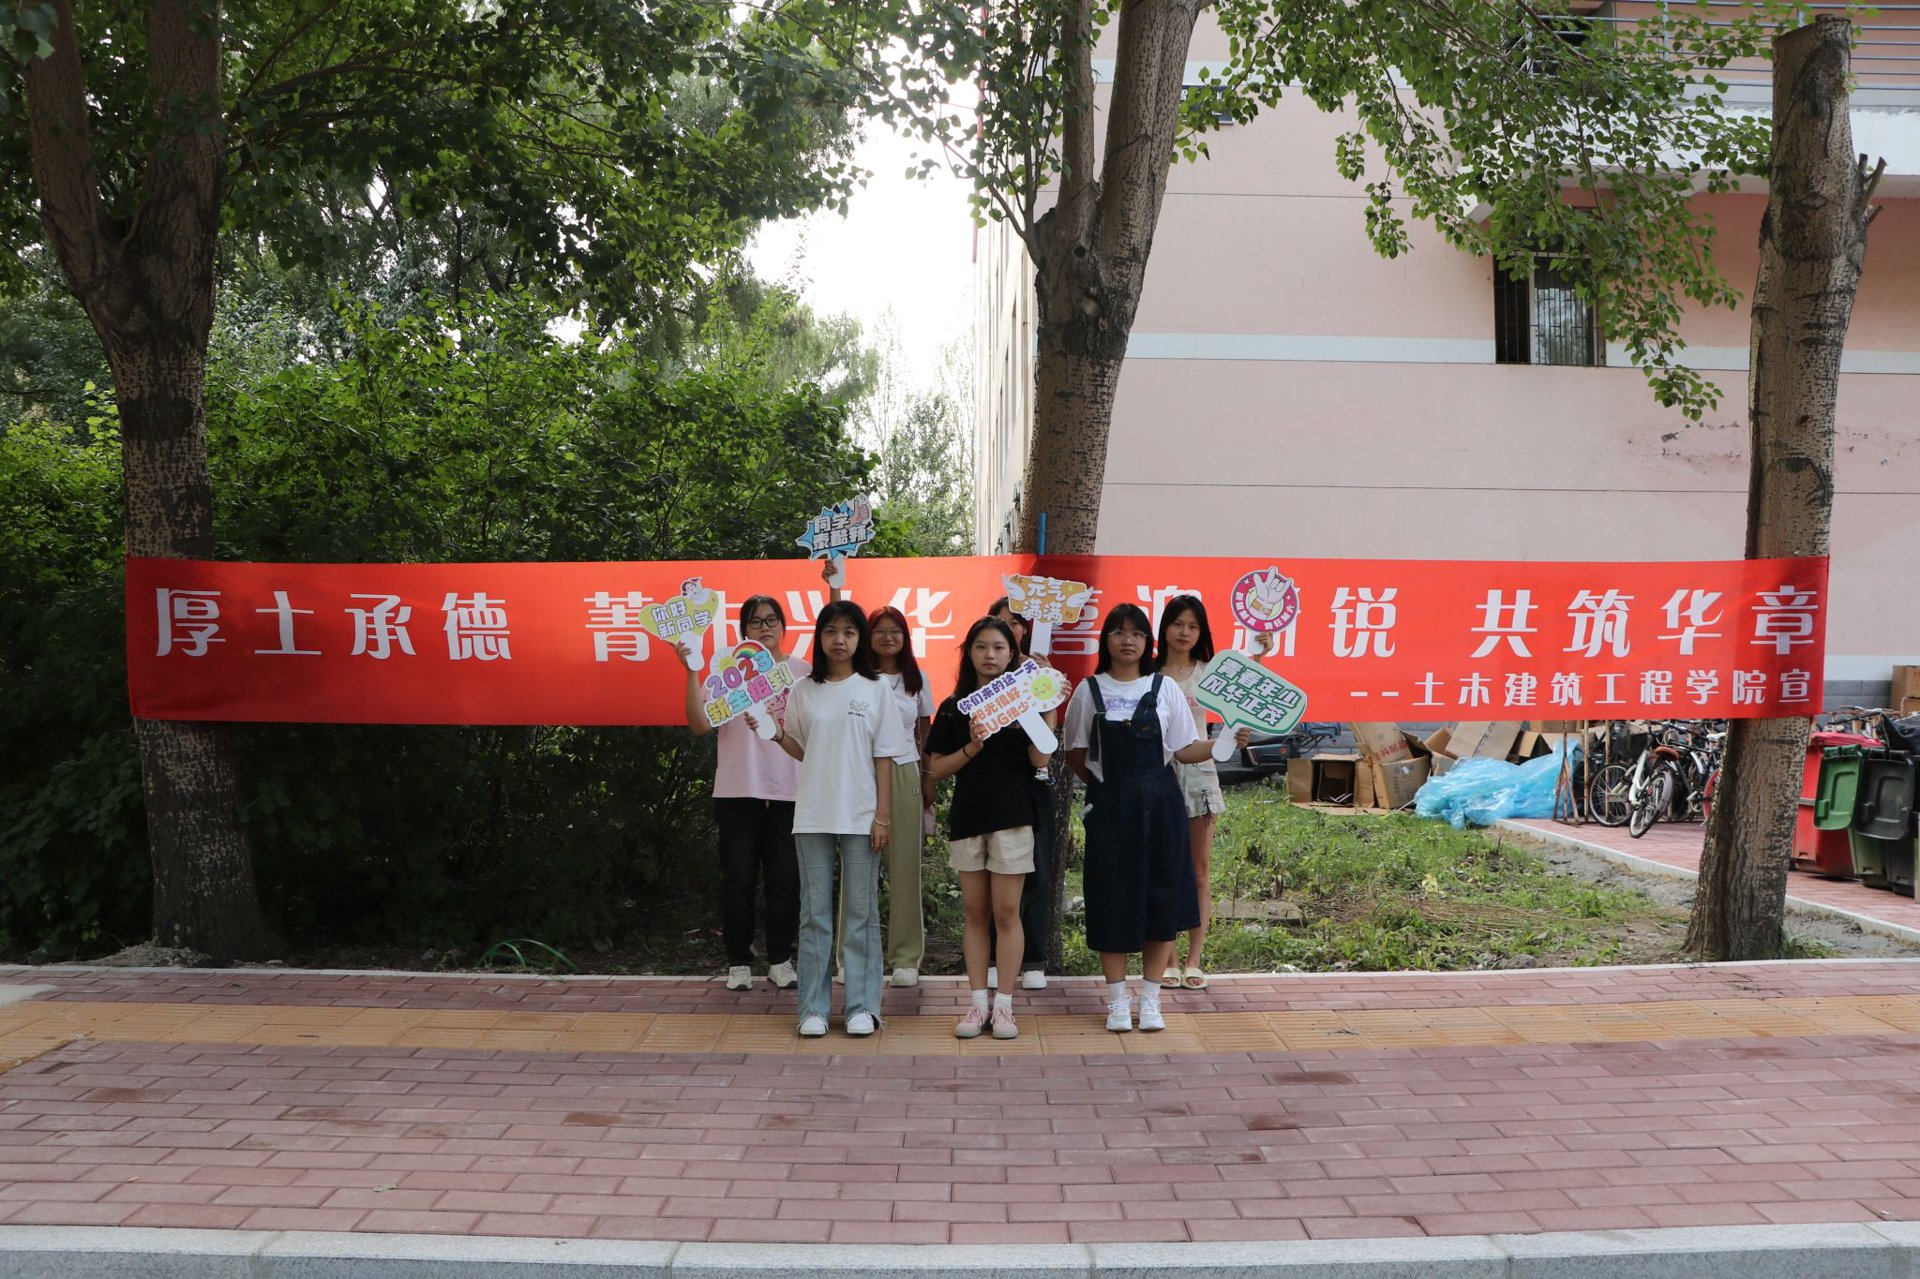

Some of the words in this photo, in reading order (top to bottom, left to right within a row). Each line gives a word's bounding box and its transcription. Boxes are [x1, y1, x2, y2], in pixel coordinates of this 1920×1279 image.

[813, 524, 867, 550] 泰酷辣
[814, 511, 850, 534] 同学
[1027, 576, 1066, 601] 元气
[155, 587, 514, 661] 厚土承德
[1469, 585, 1819, 659] 共筑华章
[652, 600, 687, 623] 你好
[657, 610, 712, 639] 新同学
[1021, 599, 1064, 626] 满满
[706, 650, 774, 699] 2023
[706, 662, 794, 725] 新生报到
[959, 660, 1038, 713] 你们来的这一天
[1215, 656, 1302, 710] 青春年少
[1199, 672, 1288, 728] 风华正茂
